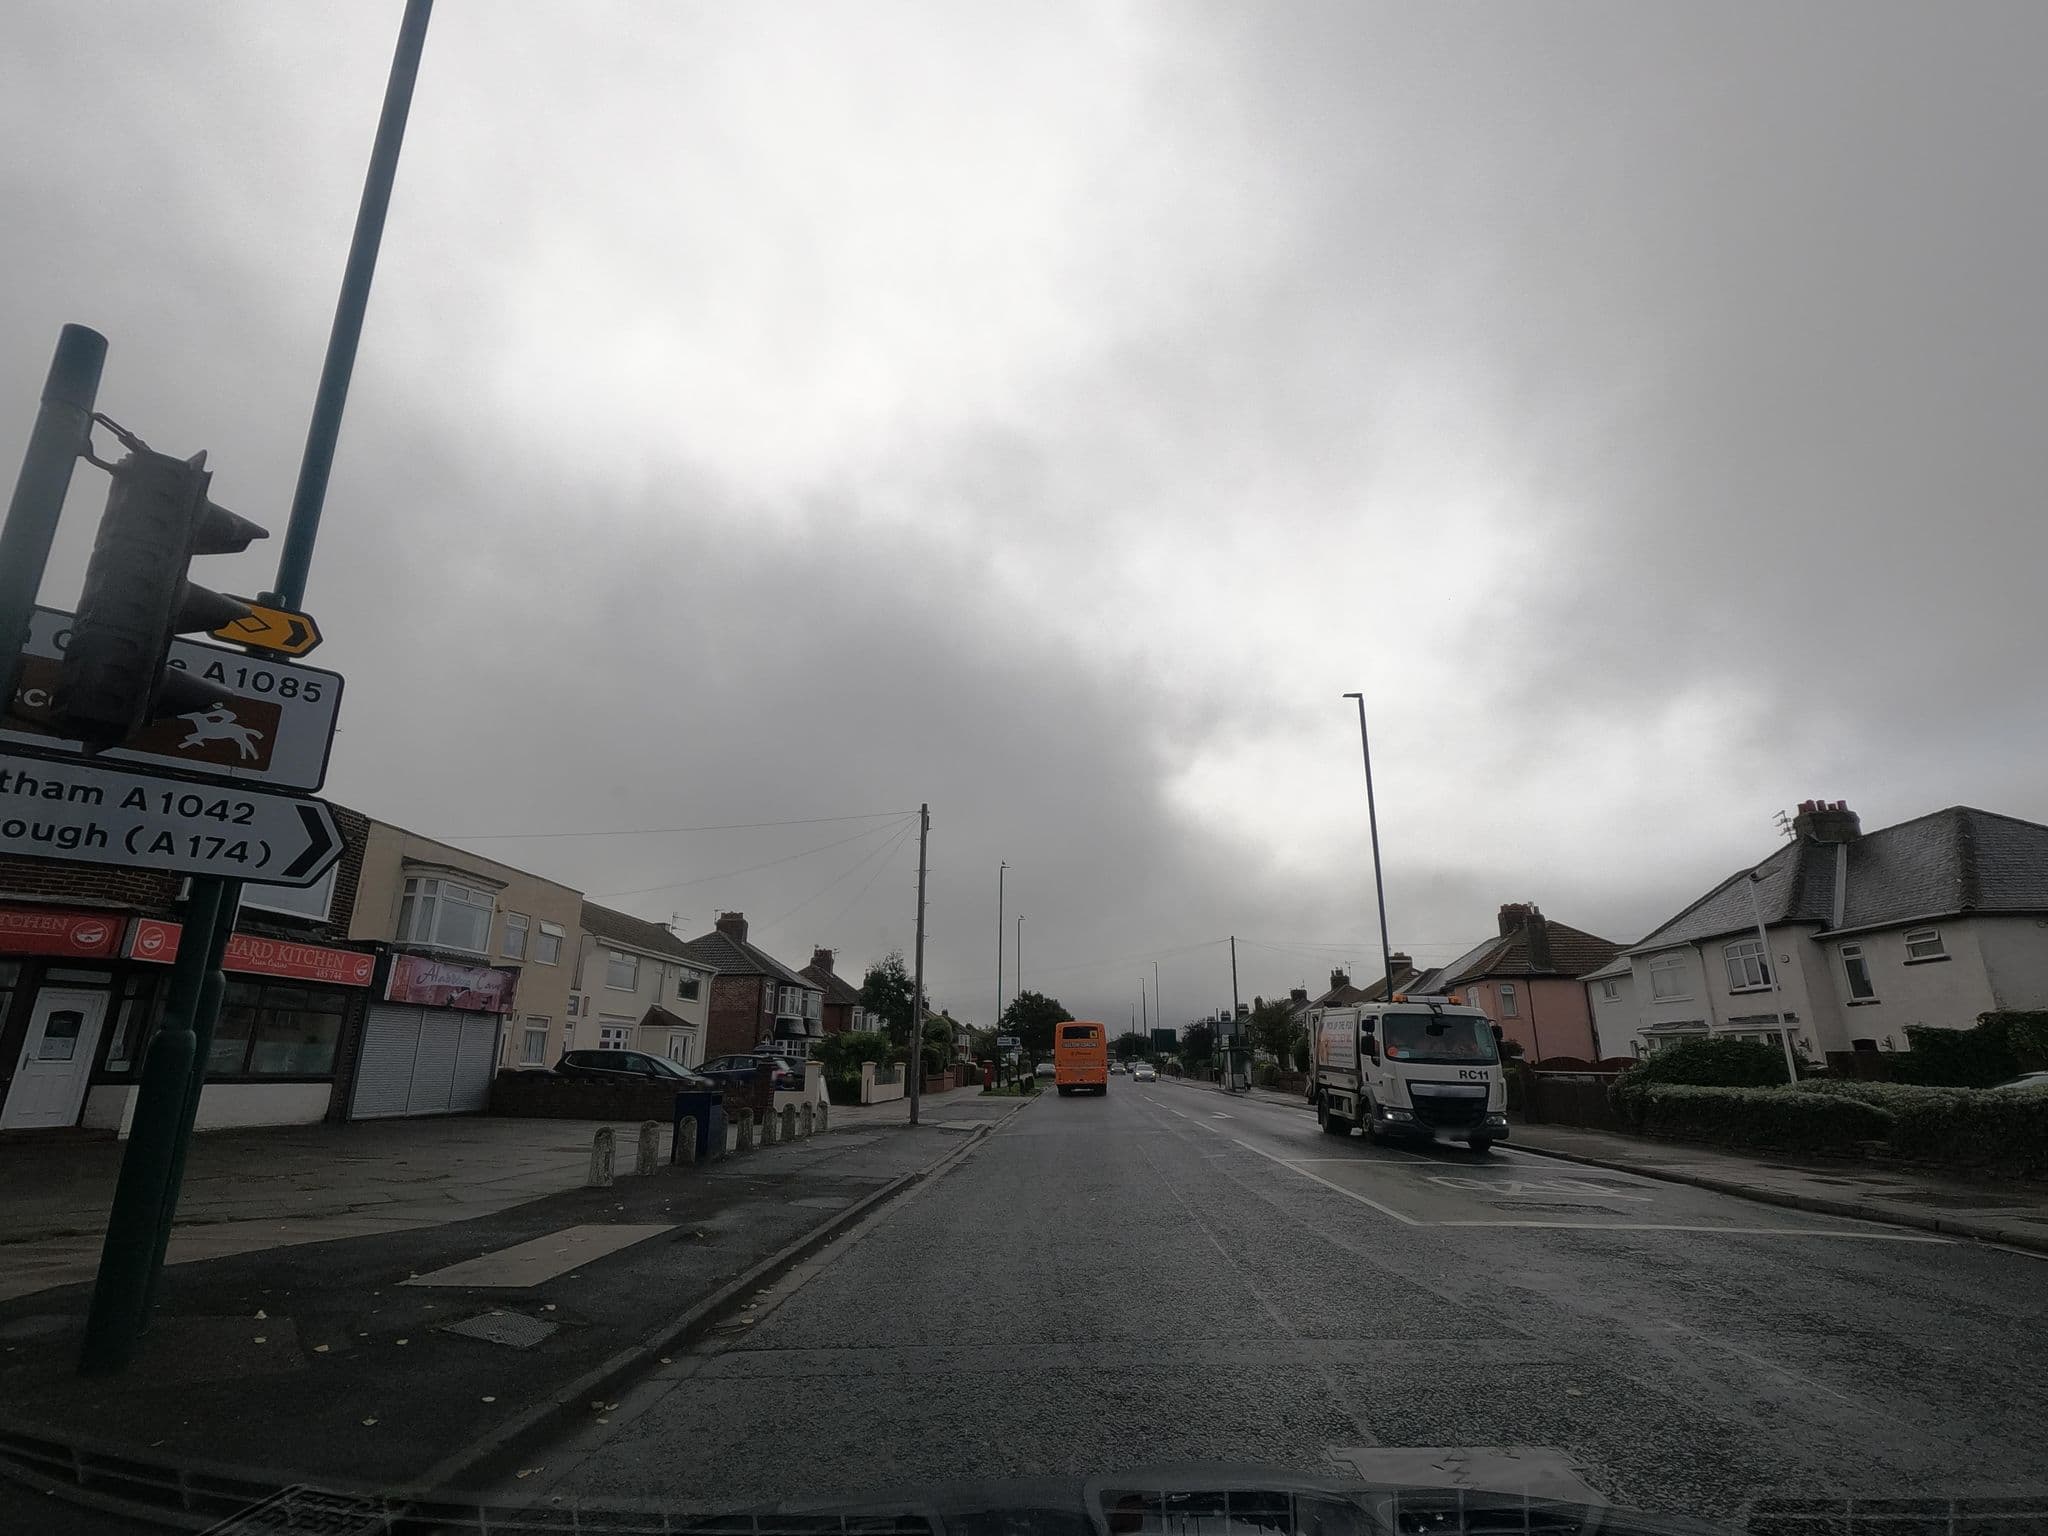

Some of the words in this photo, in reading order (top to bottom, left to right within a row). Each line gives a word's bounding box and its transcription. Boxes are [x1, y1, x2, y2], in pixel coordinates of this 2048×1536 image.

[0, 819, 108, 850] ough
[277, 944, 346, 969] KITCHEN
[1458, 1069, 1489, 1081] RC11
